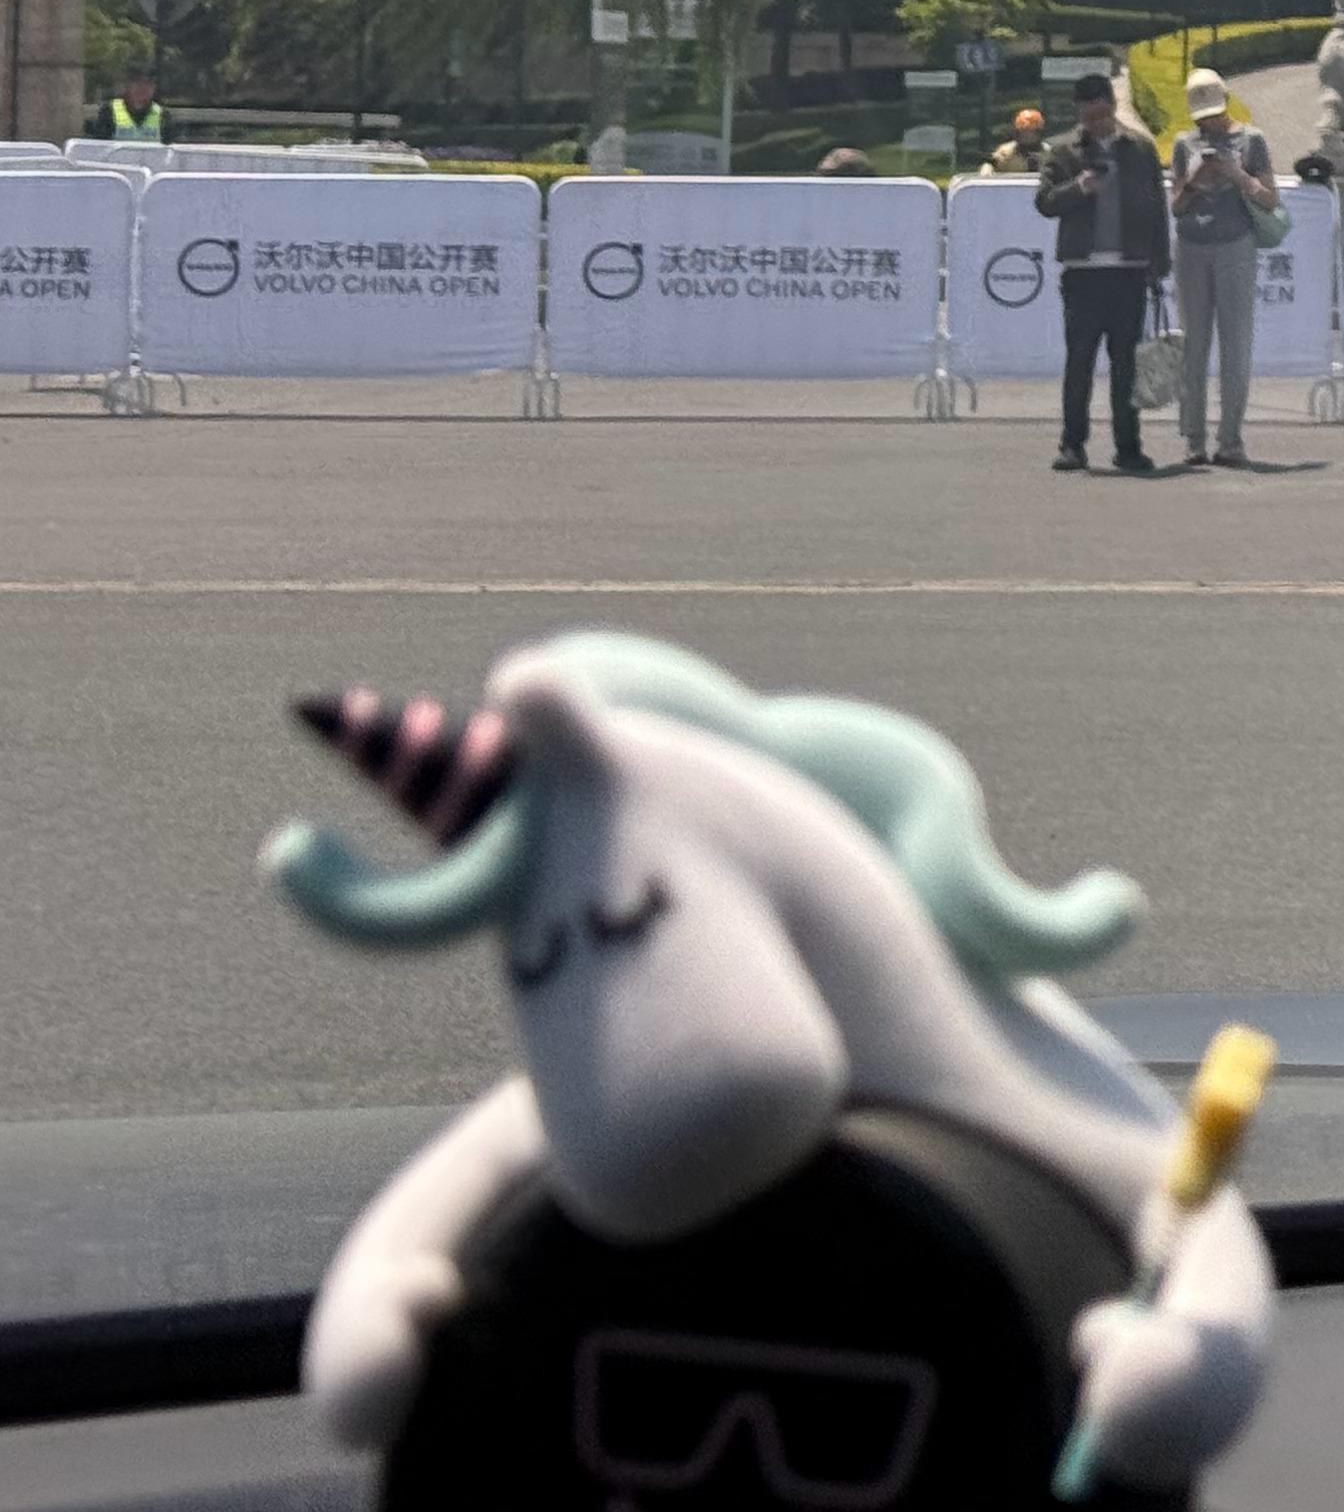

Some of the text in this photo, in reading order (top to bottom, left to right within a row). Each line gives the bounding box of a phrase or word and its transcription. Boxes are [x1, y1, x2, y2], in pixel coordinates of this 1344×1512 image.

[254, 240, 499, 273] 沃尔沃中国公开赛
[658, 244, 901, 276] 沃尔沃中国公开赛
[21, 278, 91, 300] OPEN
[254, 273, 500, 297] VOLVO CHINA OPEN
[657, 277, 901, 302] VOLVO CHINA OPEN
[1258, 285, 1295, 303] EN
